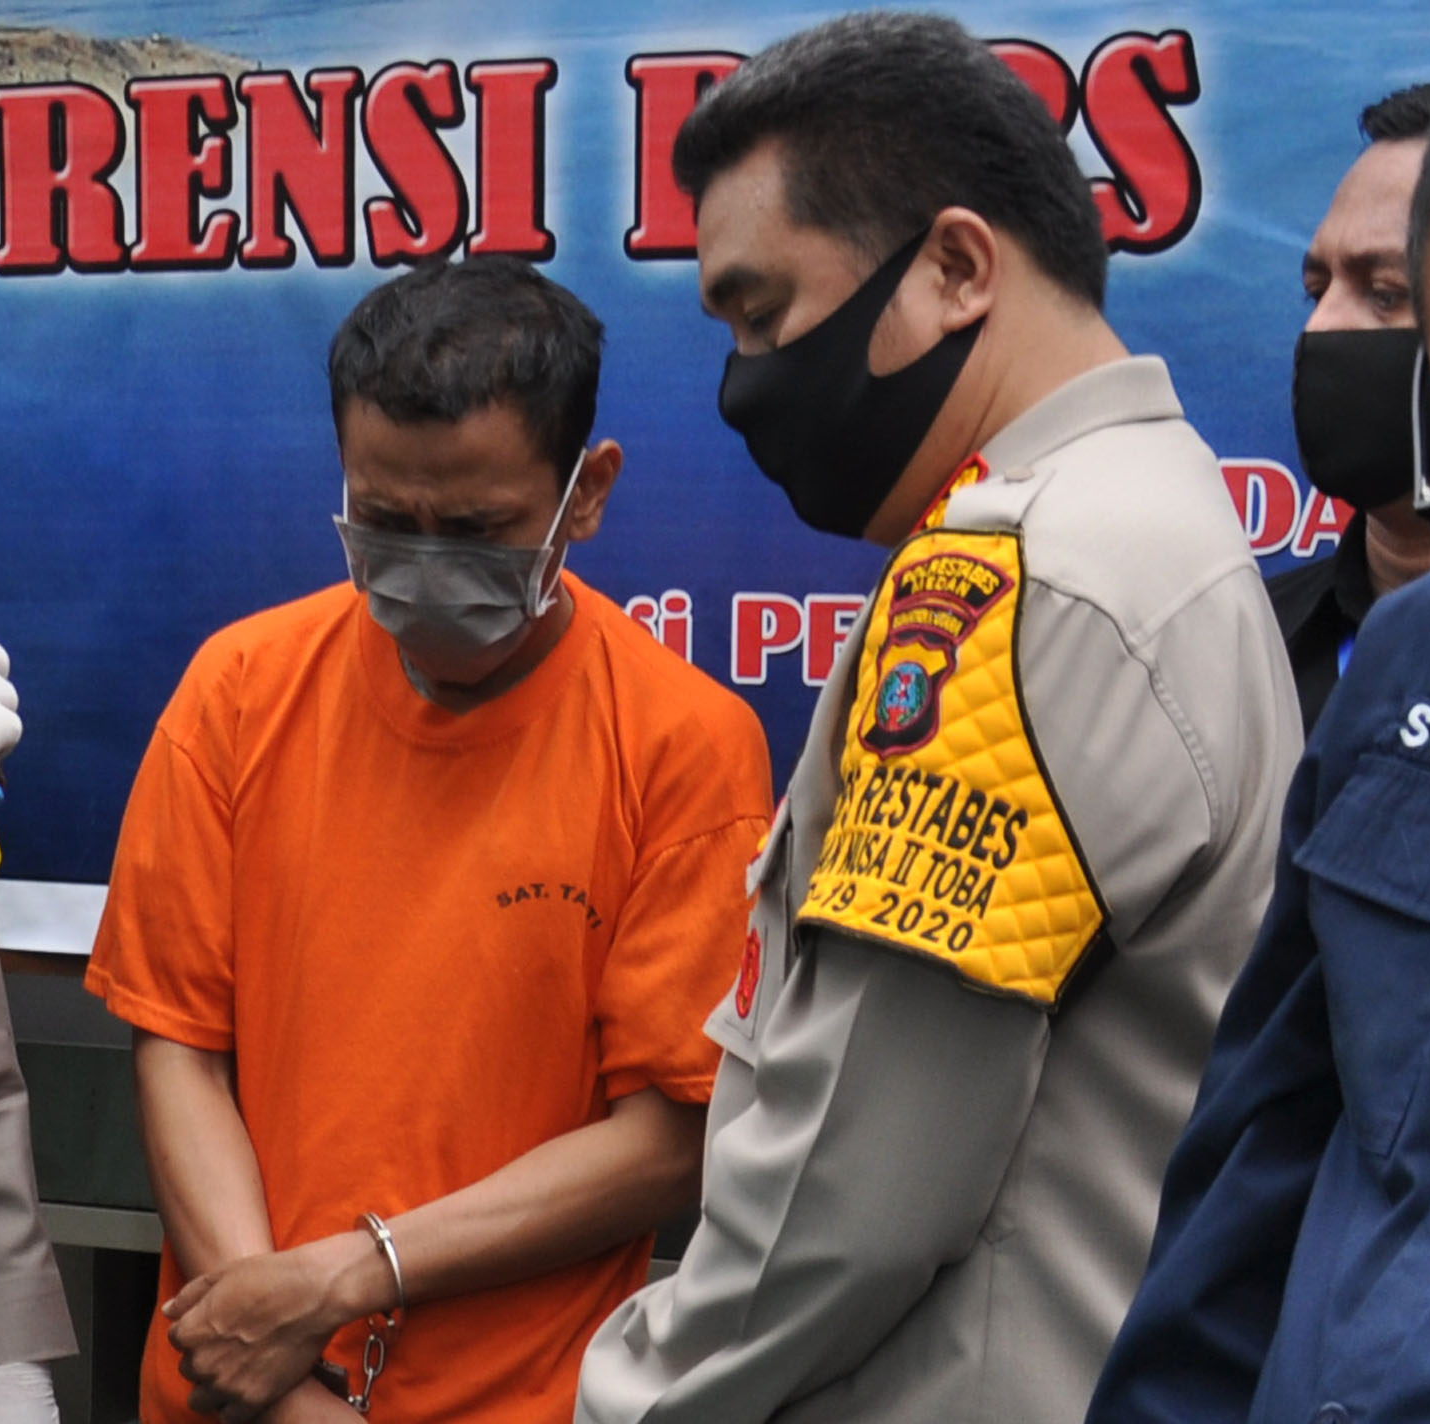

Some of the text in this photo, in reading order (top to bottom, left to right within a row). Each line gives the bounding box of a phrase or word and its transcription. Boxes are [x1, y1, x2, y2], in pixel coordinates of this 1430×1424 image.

[496, 882, 550, 909] SAT.
[921, 850, 997, 921] TOBA
[870, 890, 974, 954] 2020
